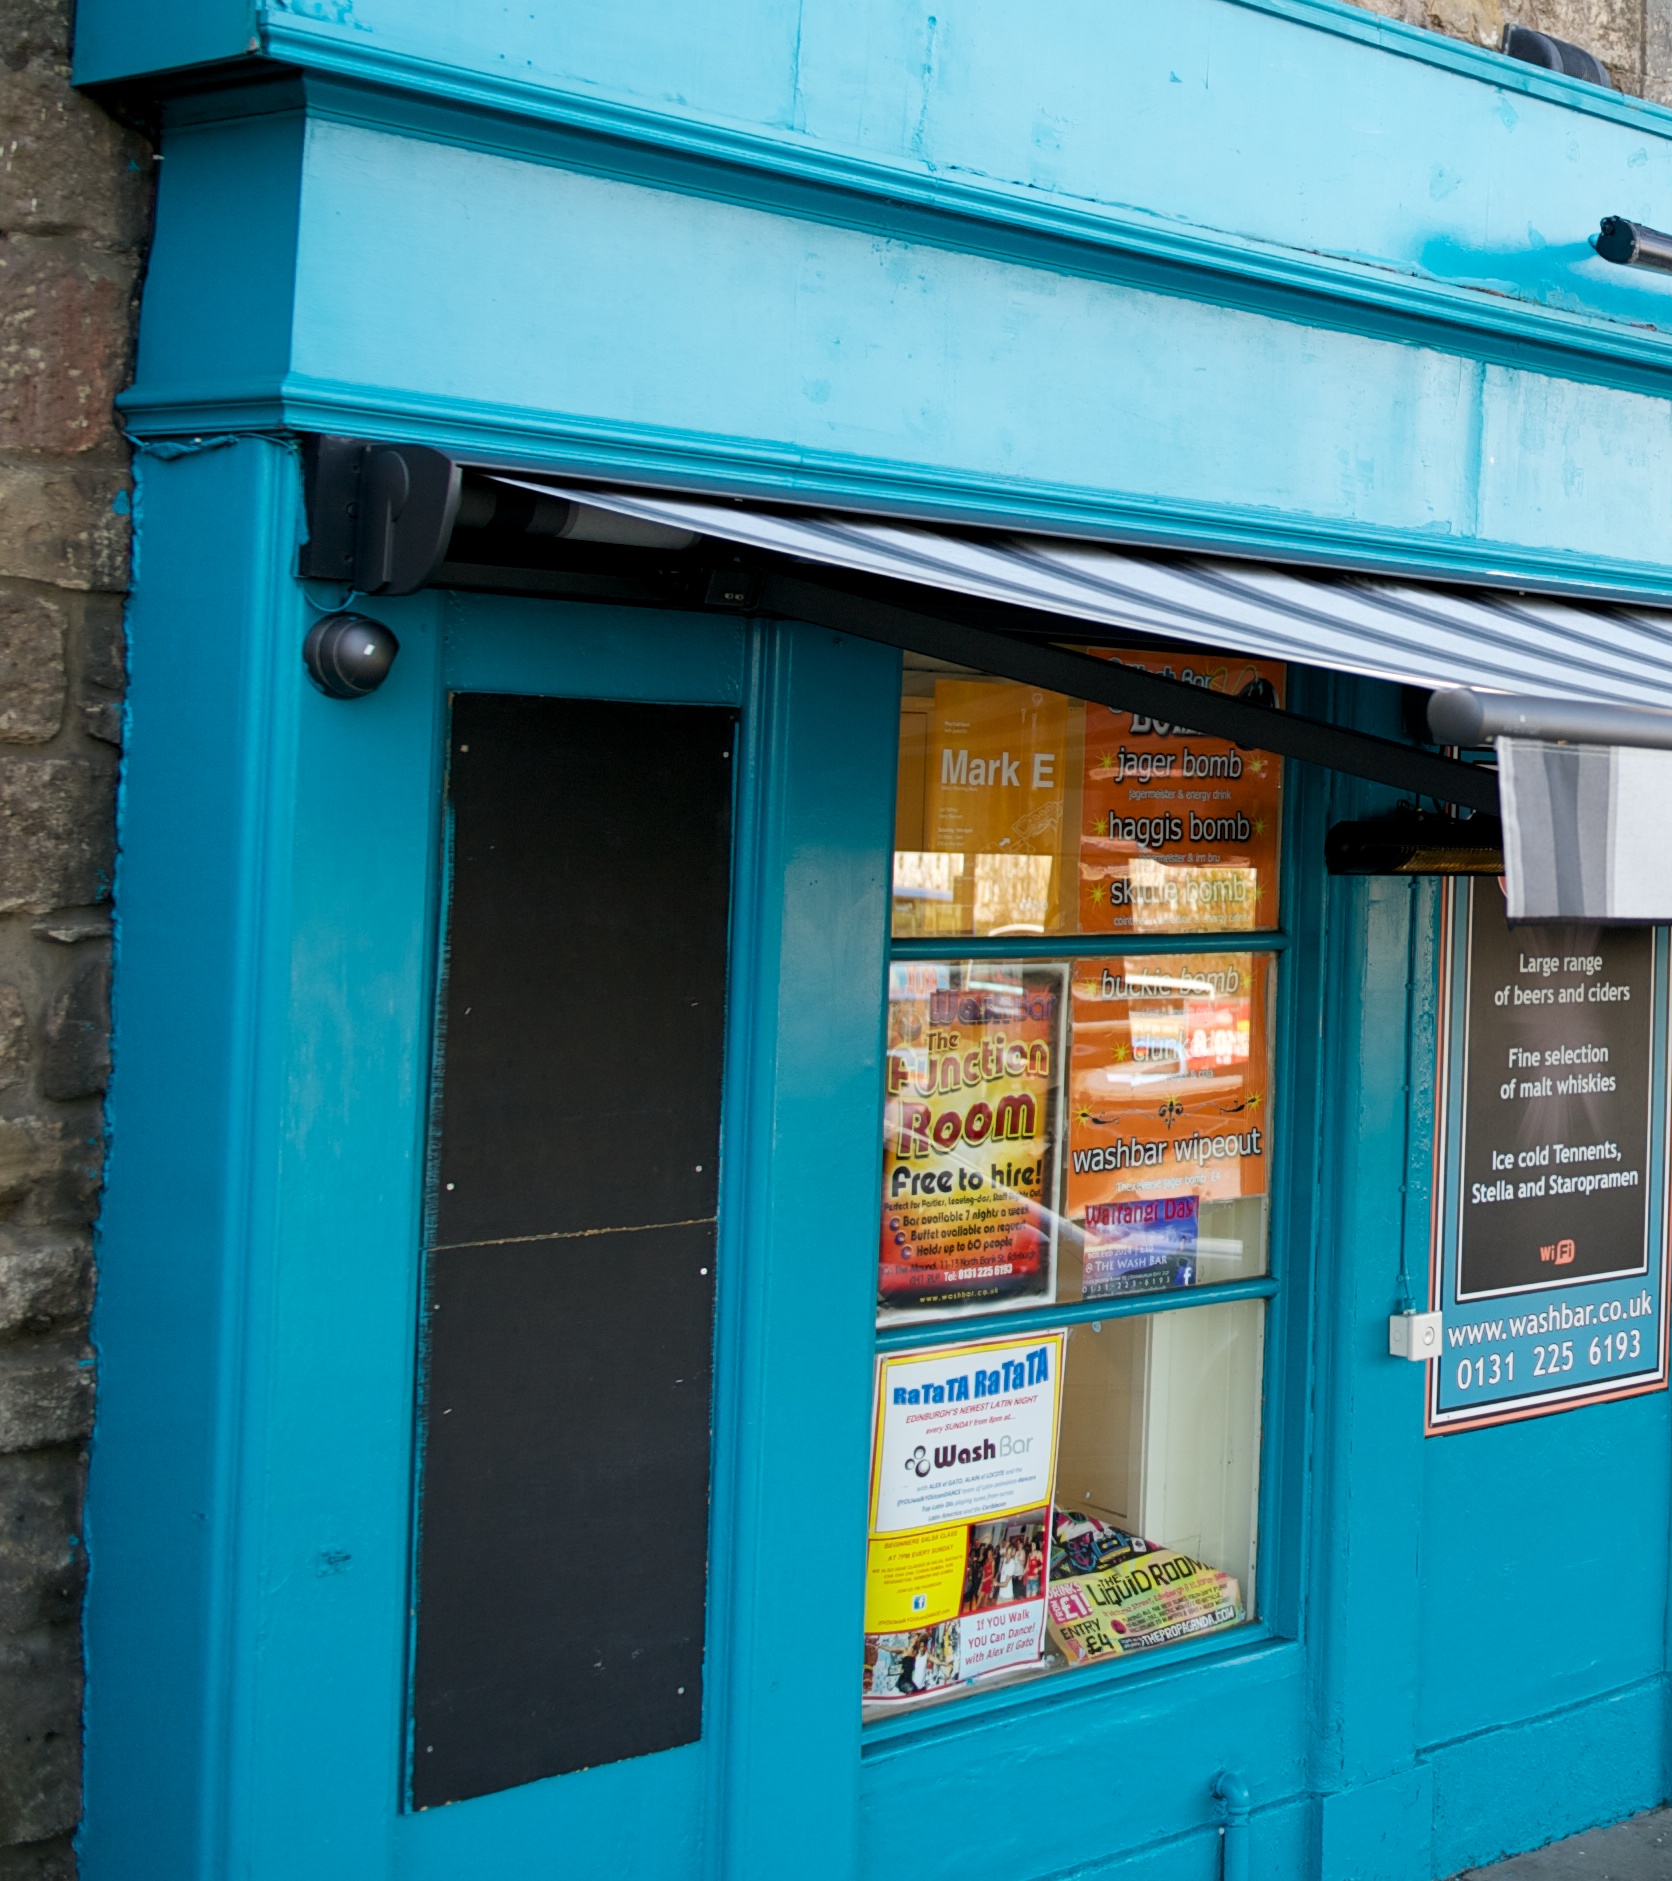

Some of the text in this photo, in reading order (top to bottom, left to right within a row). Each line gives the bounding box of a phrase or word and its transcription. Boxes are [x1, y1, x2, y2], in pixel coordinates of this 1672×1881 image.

[941, 748, 1055, 788] Mark E
[1114, 747, 1243, 782] jager bomb
[1109, 811, 1250, 848] haggis bomb
[1186, 874, 1246, 902] bomb
[1520, 953, 1602, 976] Large range
[1180, 966, 1239, 994] bomb
[1495, 982, 1630, 1005] of beers and ciders
[927, 1029, 960, 1052] The
[888, 1033, 1049, 1096] Function
[1509, 1044, 1608, 1068] Fine selection
[1500, 1073, 1616, 1099] of malt whiskies
[897, 1090, 1037, 1159] Room
[1073, 1128, 1262, 1173] washbar wipeout
[1492, 1141, 1621, 1170] Ice cold Tennents,
[892, 1160, 1043, 1197] Free to hire!
[1472, 1171, 1638, 1204] Stella and Staropramen
[903, 1216, 919, 1226] Bar
[922, 1211, 963, 1225] available
[965, 1210, 970, 1221] 7
[972, 1207, 998, 1222] nights
[1008, 1205, 1030, 1216] week
[911, 1225, 995, 1241] Buffet available on
[917, 1237, 1012, 1257] Holds up to 60 people
[958, 1268, 976, 1280] 0131
[977, 1266, 993, 1278] 225
[1095, 1260, 1114, 1272] THE
[1117, 1257, 1146, 1269] WASH
[1150, 1255, 1168, 1265] BAR
[1448, 1289, 1653, 1348] www.washbar.co.uk
[1457, 1330, 1640, 1390] 0131 225 6193
[959, 1402, 990, 1415] NEWEST
[990, 1399, 1012, 1409] LATIN
[1013, 1395, 1038, 1405] NIGHT
[945, 1420, 973, 1431] SUNDAY
[934, 1435, 1033, 1469] Wash Bar
[1048, 1581, 1082, 1599] DRINKS
[977, 1609, 1030, 1631] If YOU Walk
[1060, 1618, 1100, 1640] ENTRY
[968, 1622, 1036, 1649] YOU Can Dance!
[1086, 1633, 1114, 1655] £4
[965, 1651, 984, 1665] with
[986, 1647, 1004, 1659] Alex
[1016, 1638, 1034, 1650] Gato
